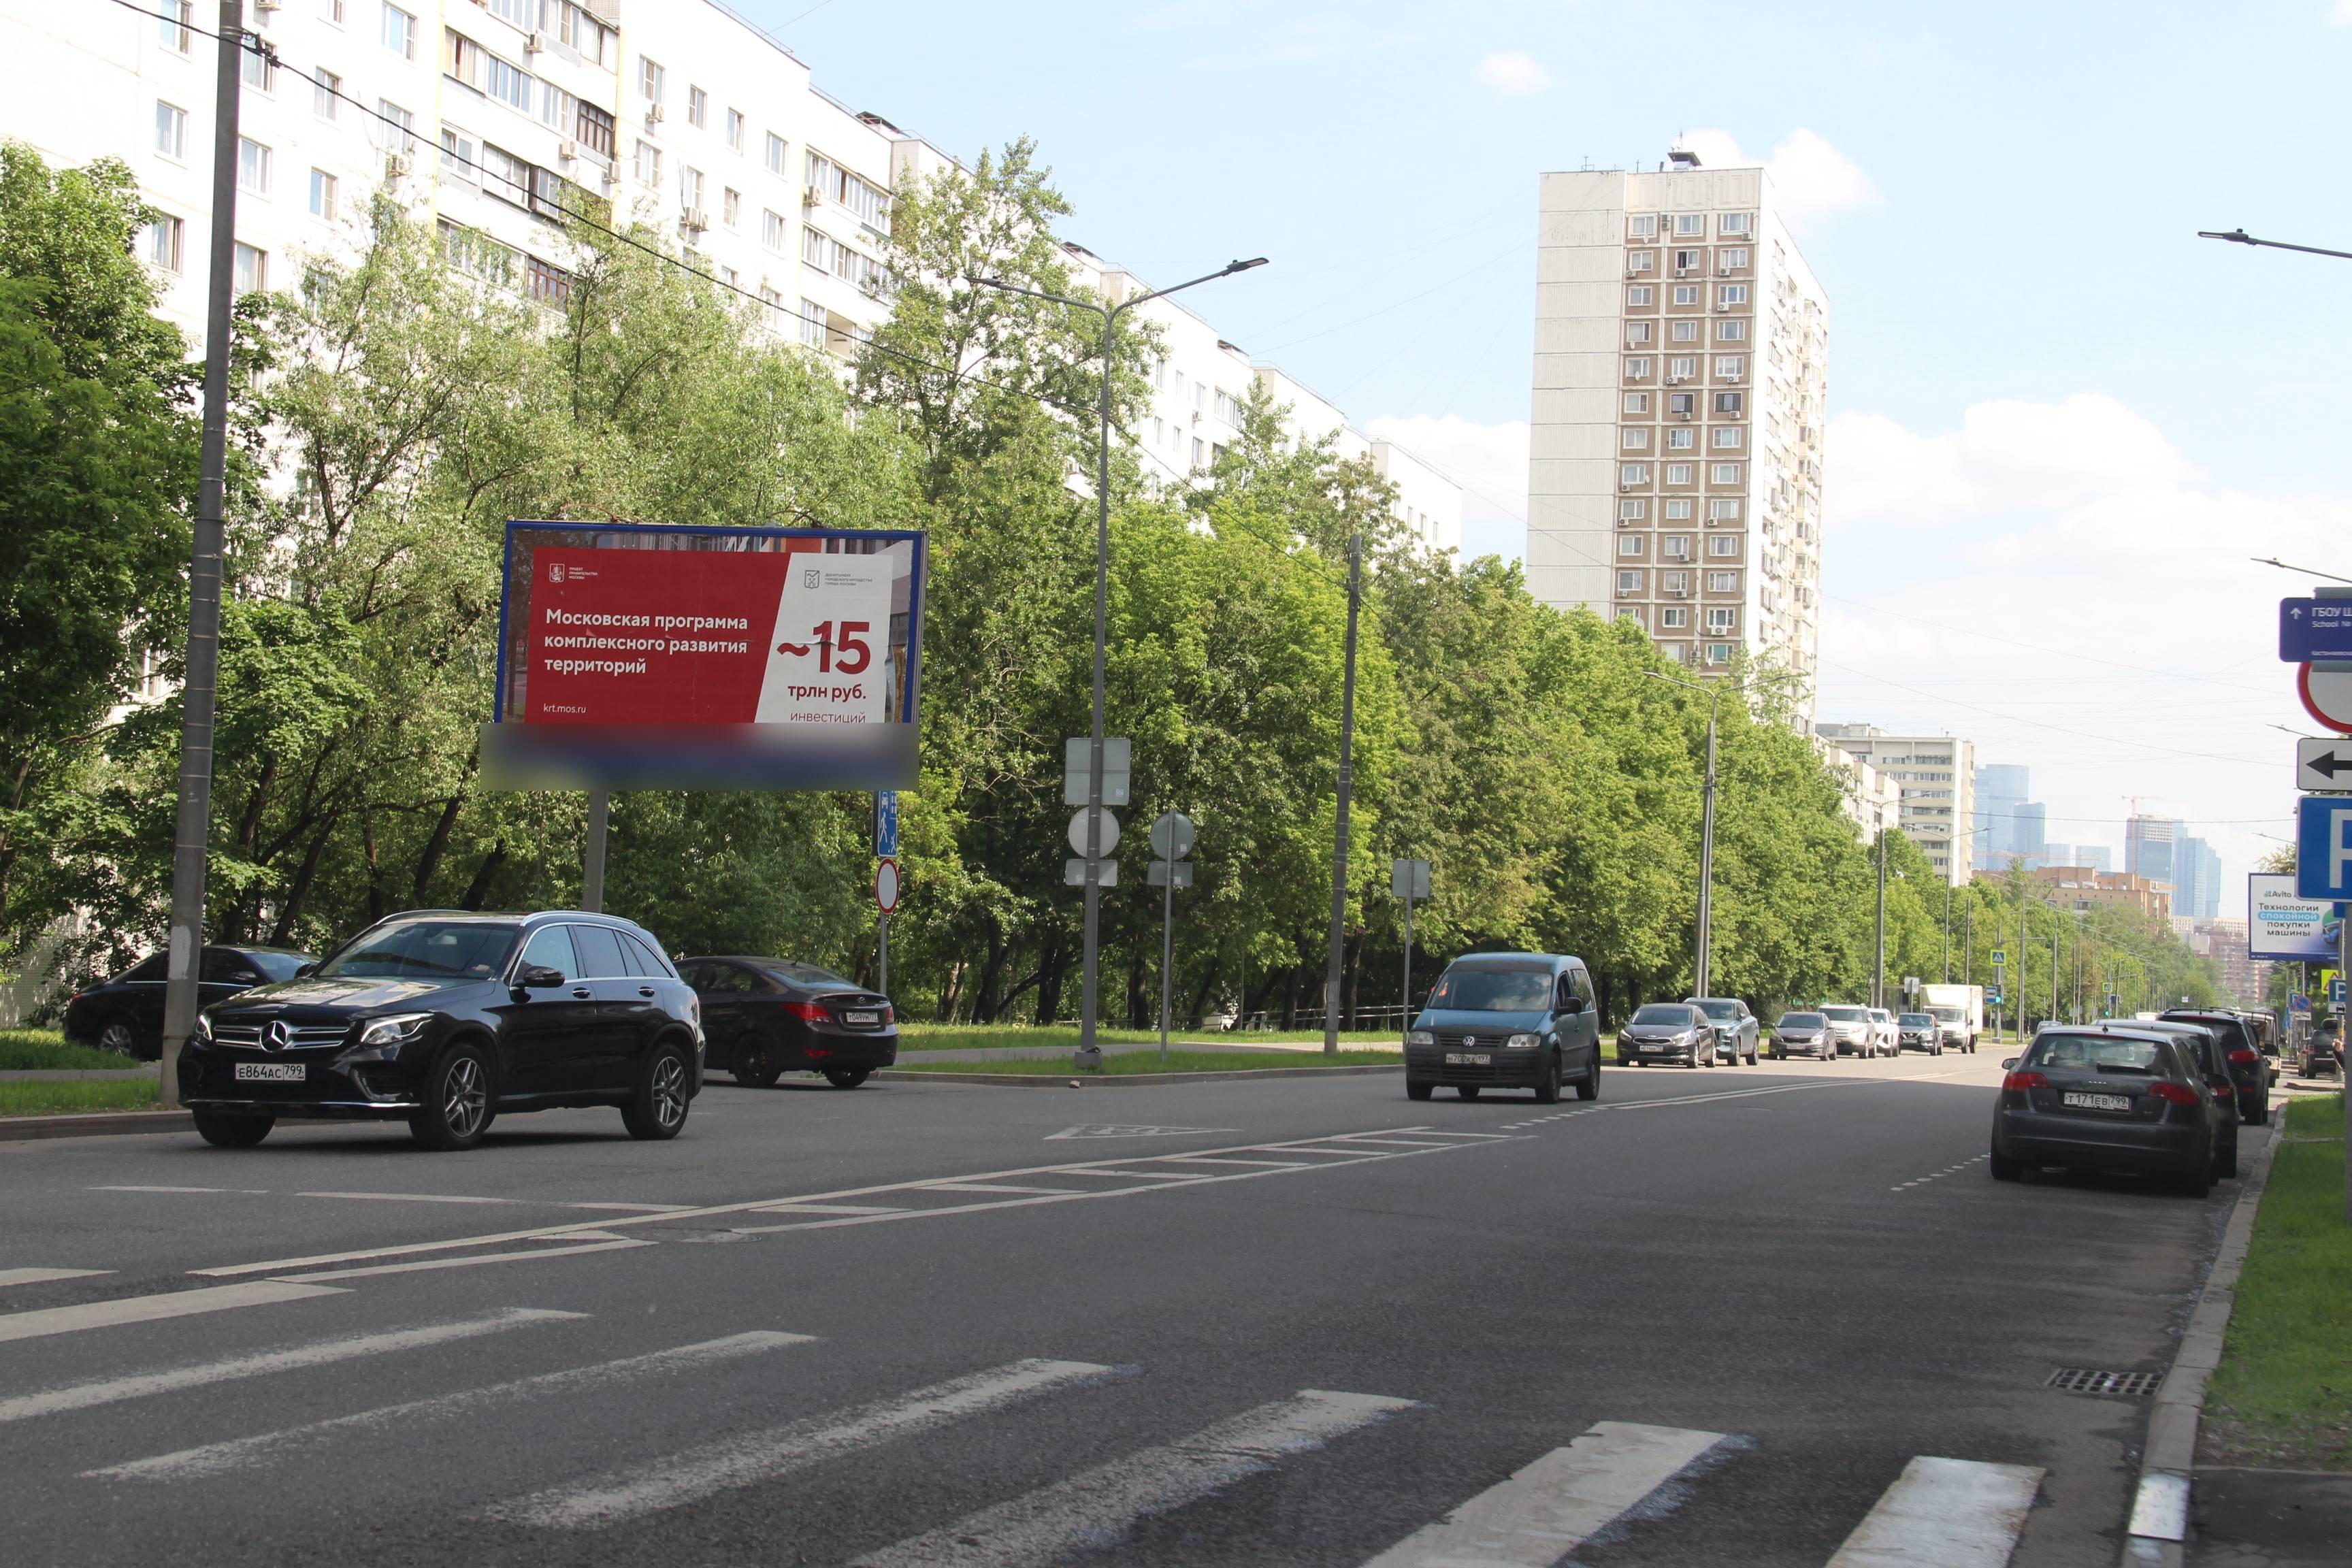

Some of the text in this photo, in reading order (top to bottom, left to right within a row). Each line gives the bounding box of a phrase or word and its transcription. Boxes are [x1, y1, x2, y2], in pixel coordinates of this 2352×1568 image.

[546, 608, 748, 632] Московская программа
[544, 636, 747, 655] комплексного развития
[544, 657, 646, 676] территорий
[787, 683, 866, 702] трлн руб.
[544, 704, 586, 713] krt.mos.ru
[790, 712, 866, 723] инвестиций
[2258, 903, 2319, 911] Технологии
[2267, 921, 2310, 930] покупки
[284, 1065, 302, 1075] 799
[2110, 1096, 2126, 1105] 799
